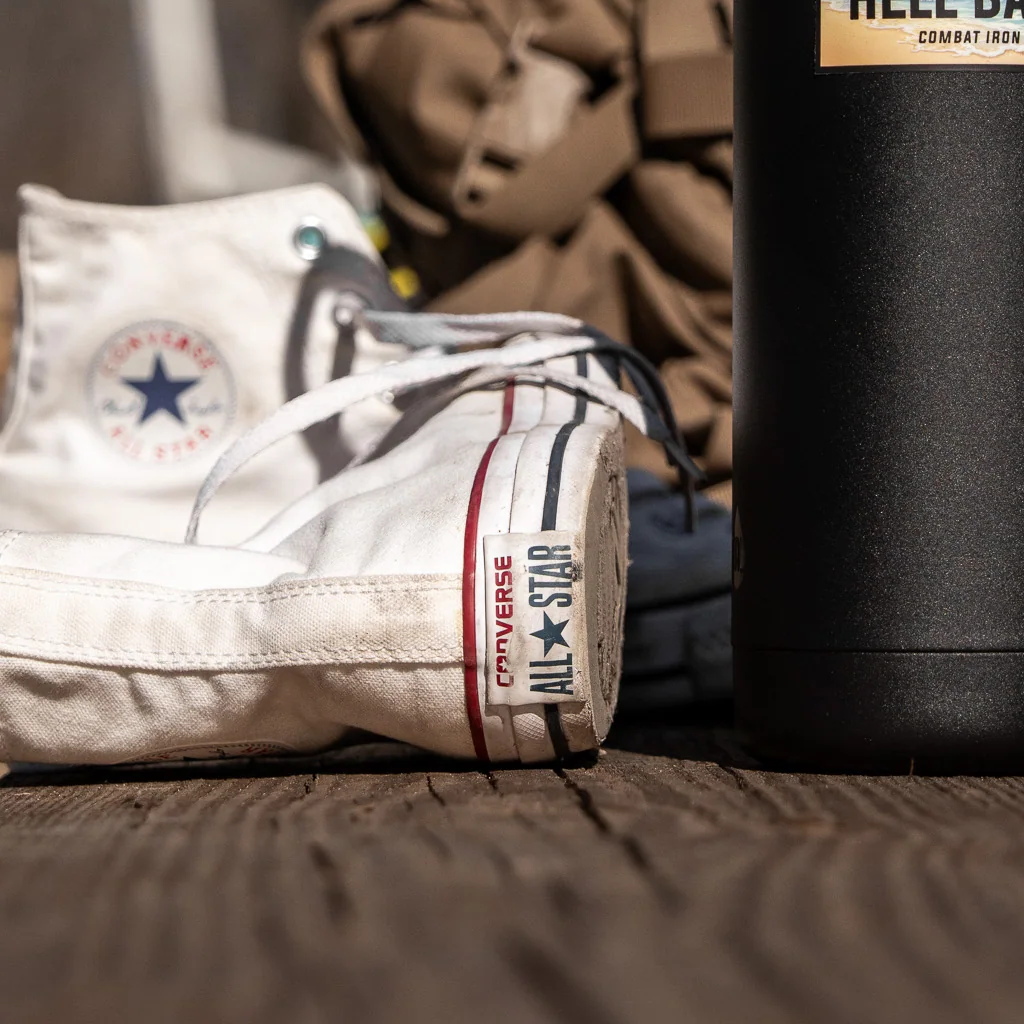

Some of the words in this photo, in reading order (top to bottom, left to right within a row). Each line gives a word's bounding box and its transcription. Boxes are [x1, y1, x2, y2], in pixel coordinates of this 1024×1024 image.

[918, 30, 981, 44] COMBAT
[985, 30, 1021, 44] IRON
[528, 545, 573, 607] STAR
[530, 653, 574, 695] ALL
